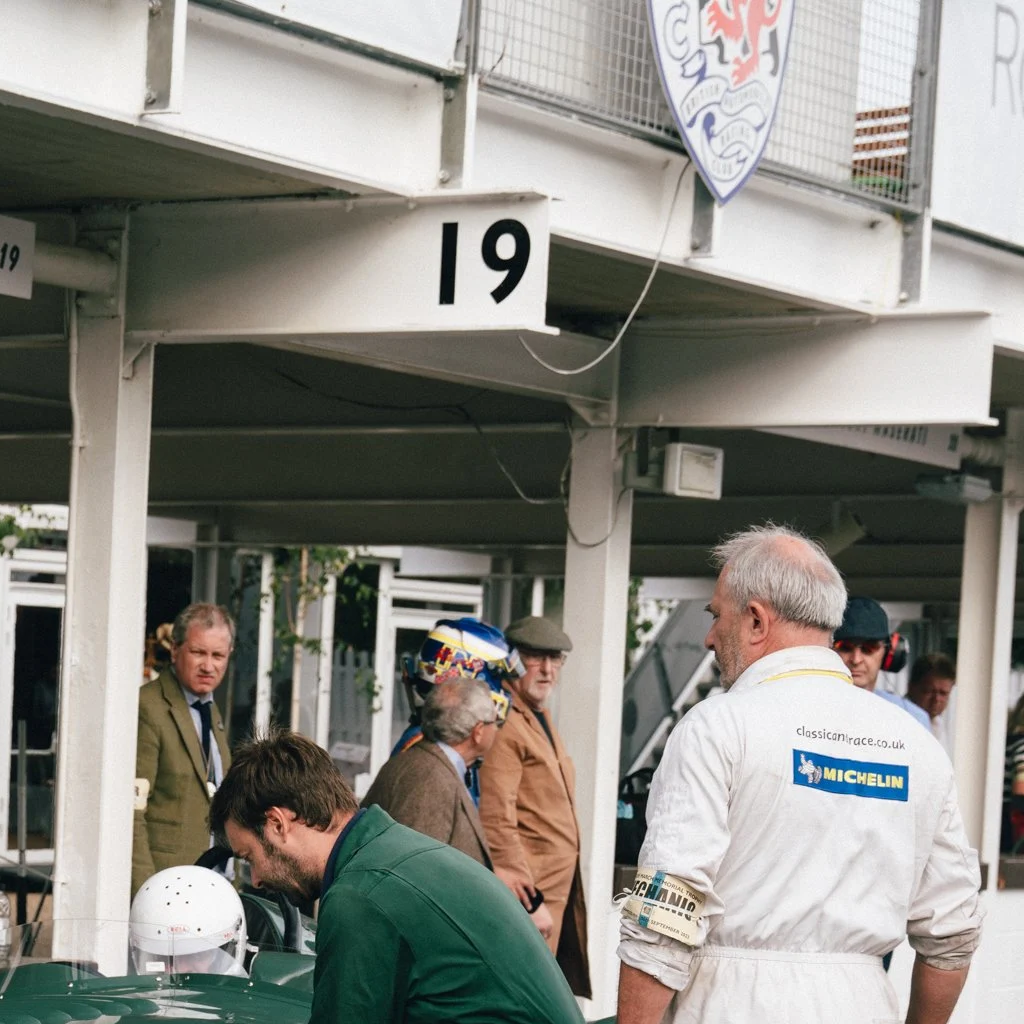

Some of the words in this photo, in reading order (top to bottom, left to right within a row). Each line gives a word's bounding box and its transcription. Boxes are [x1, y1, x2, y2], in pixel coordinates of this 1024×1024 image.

[991, 3, 1024, 119] R
[438, 218, 531, 305] 19
[822, 766, 904, 789] MICHELIN
[631, 880, 696, 922] ECHANIC
[650, 919, 680, 935] SEPTEMBER
